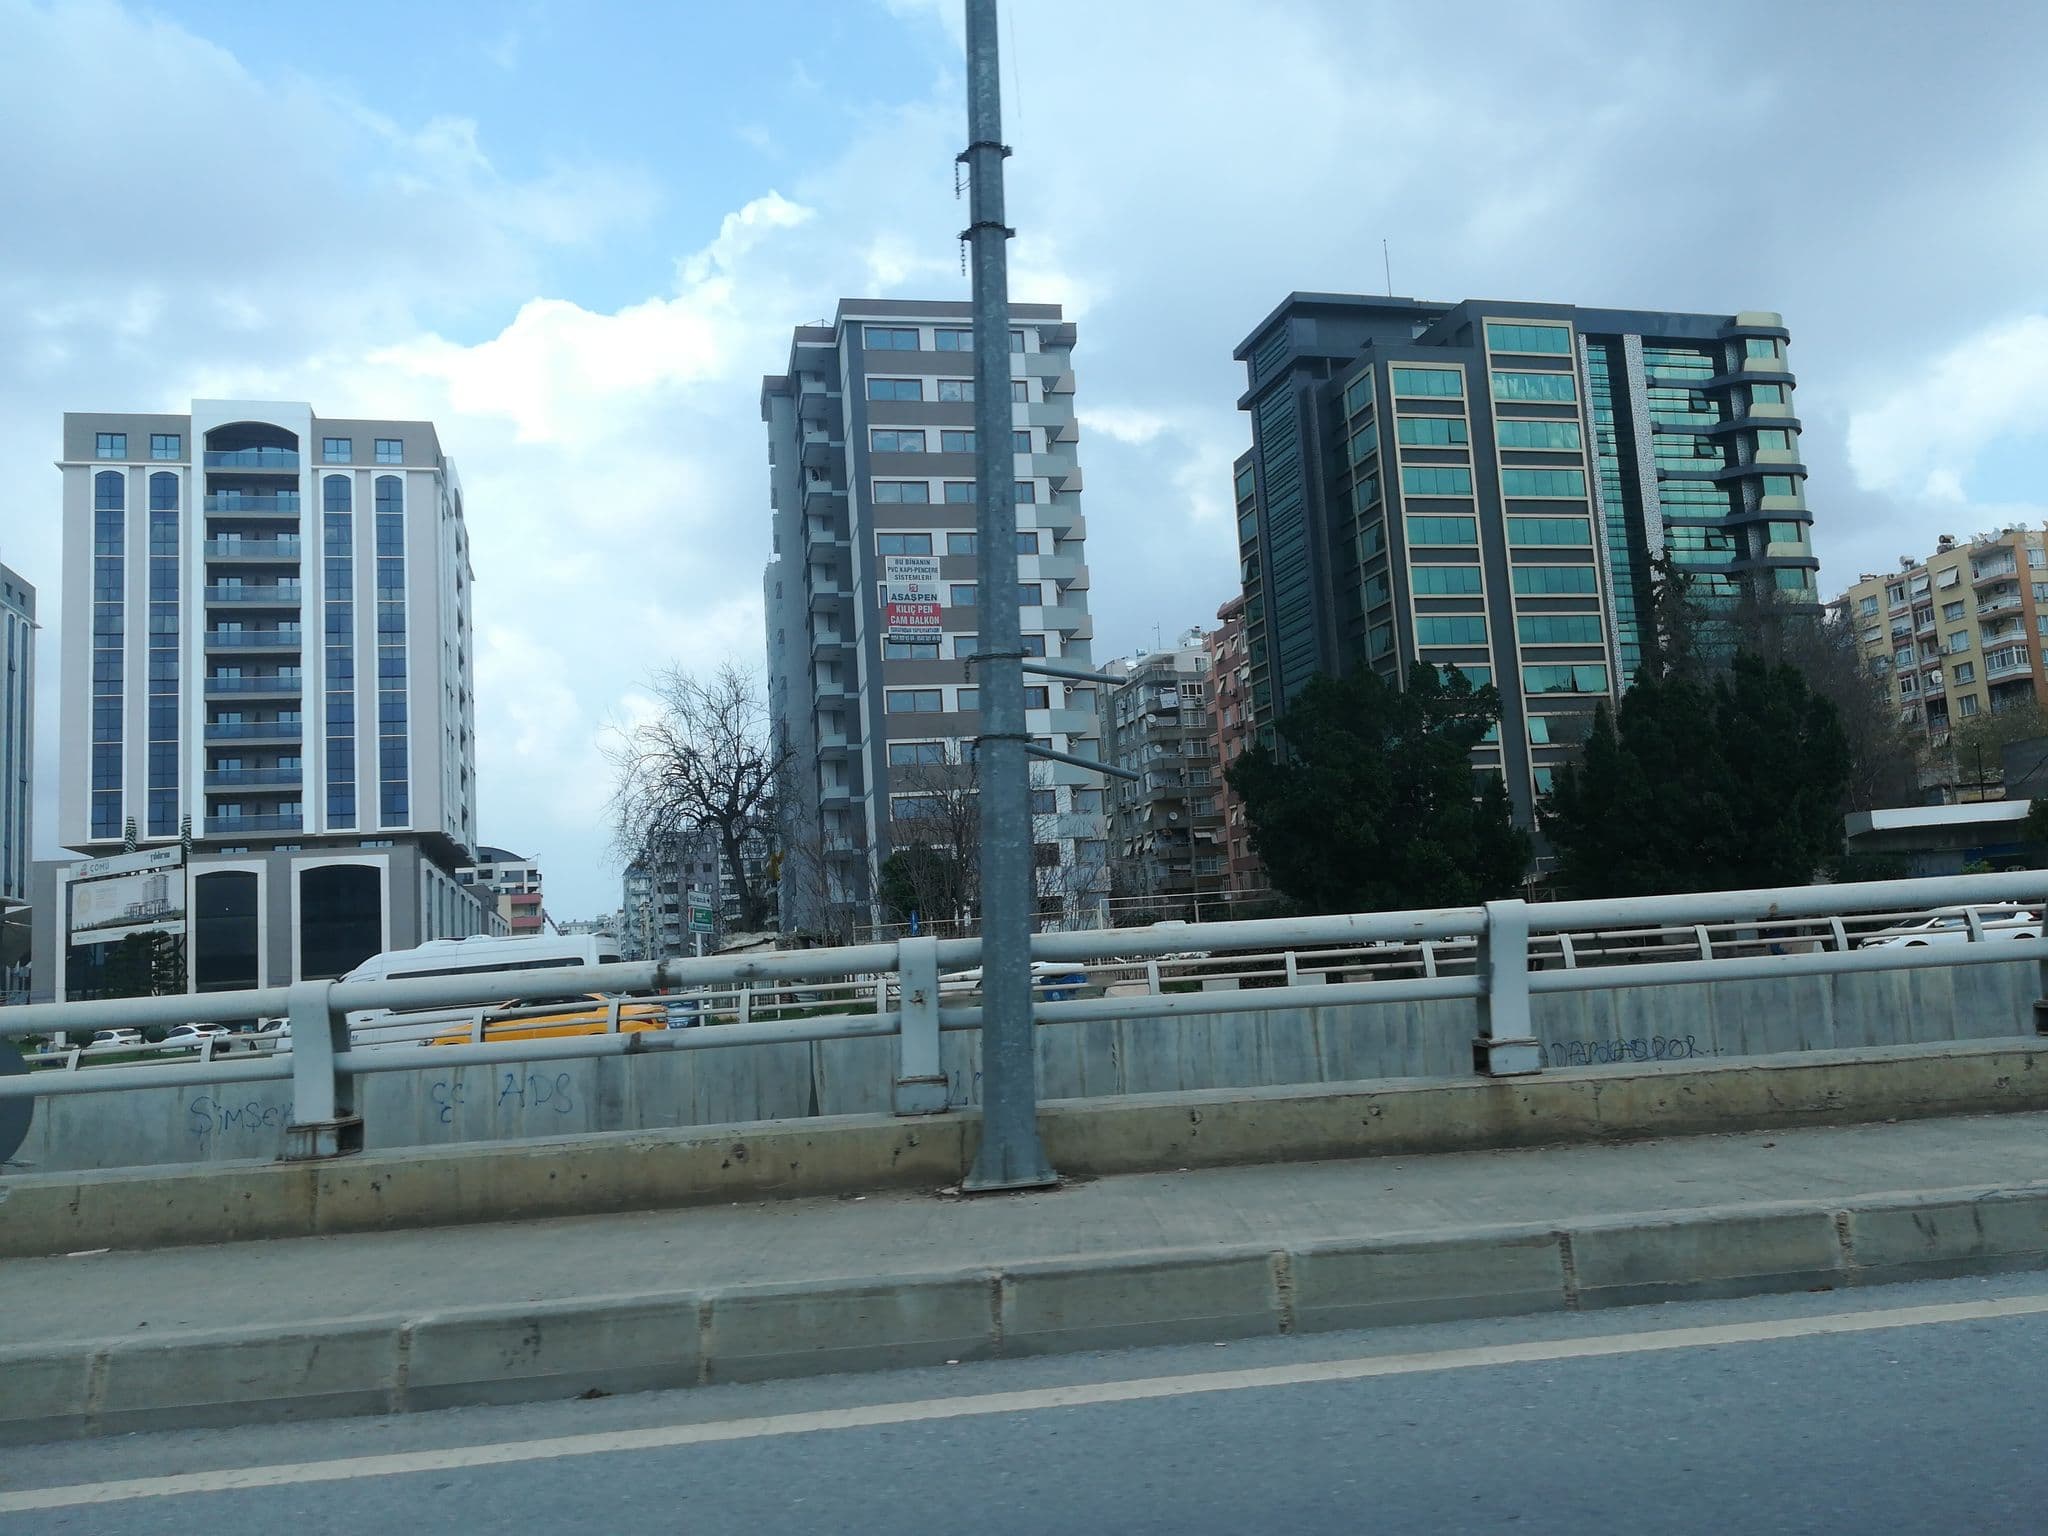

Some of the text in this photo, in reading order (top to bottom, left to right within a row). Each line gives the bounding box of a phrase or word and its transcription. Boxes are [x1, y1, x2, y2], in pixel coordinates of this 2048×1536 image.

[917, 604, 933, 614] PEN
[890, 615, 940, 625] CAM BALKON
